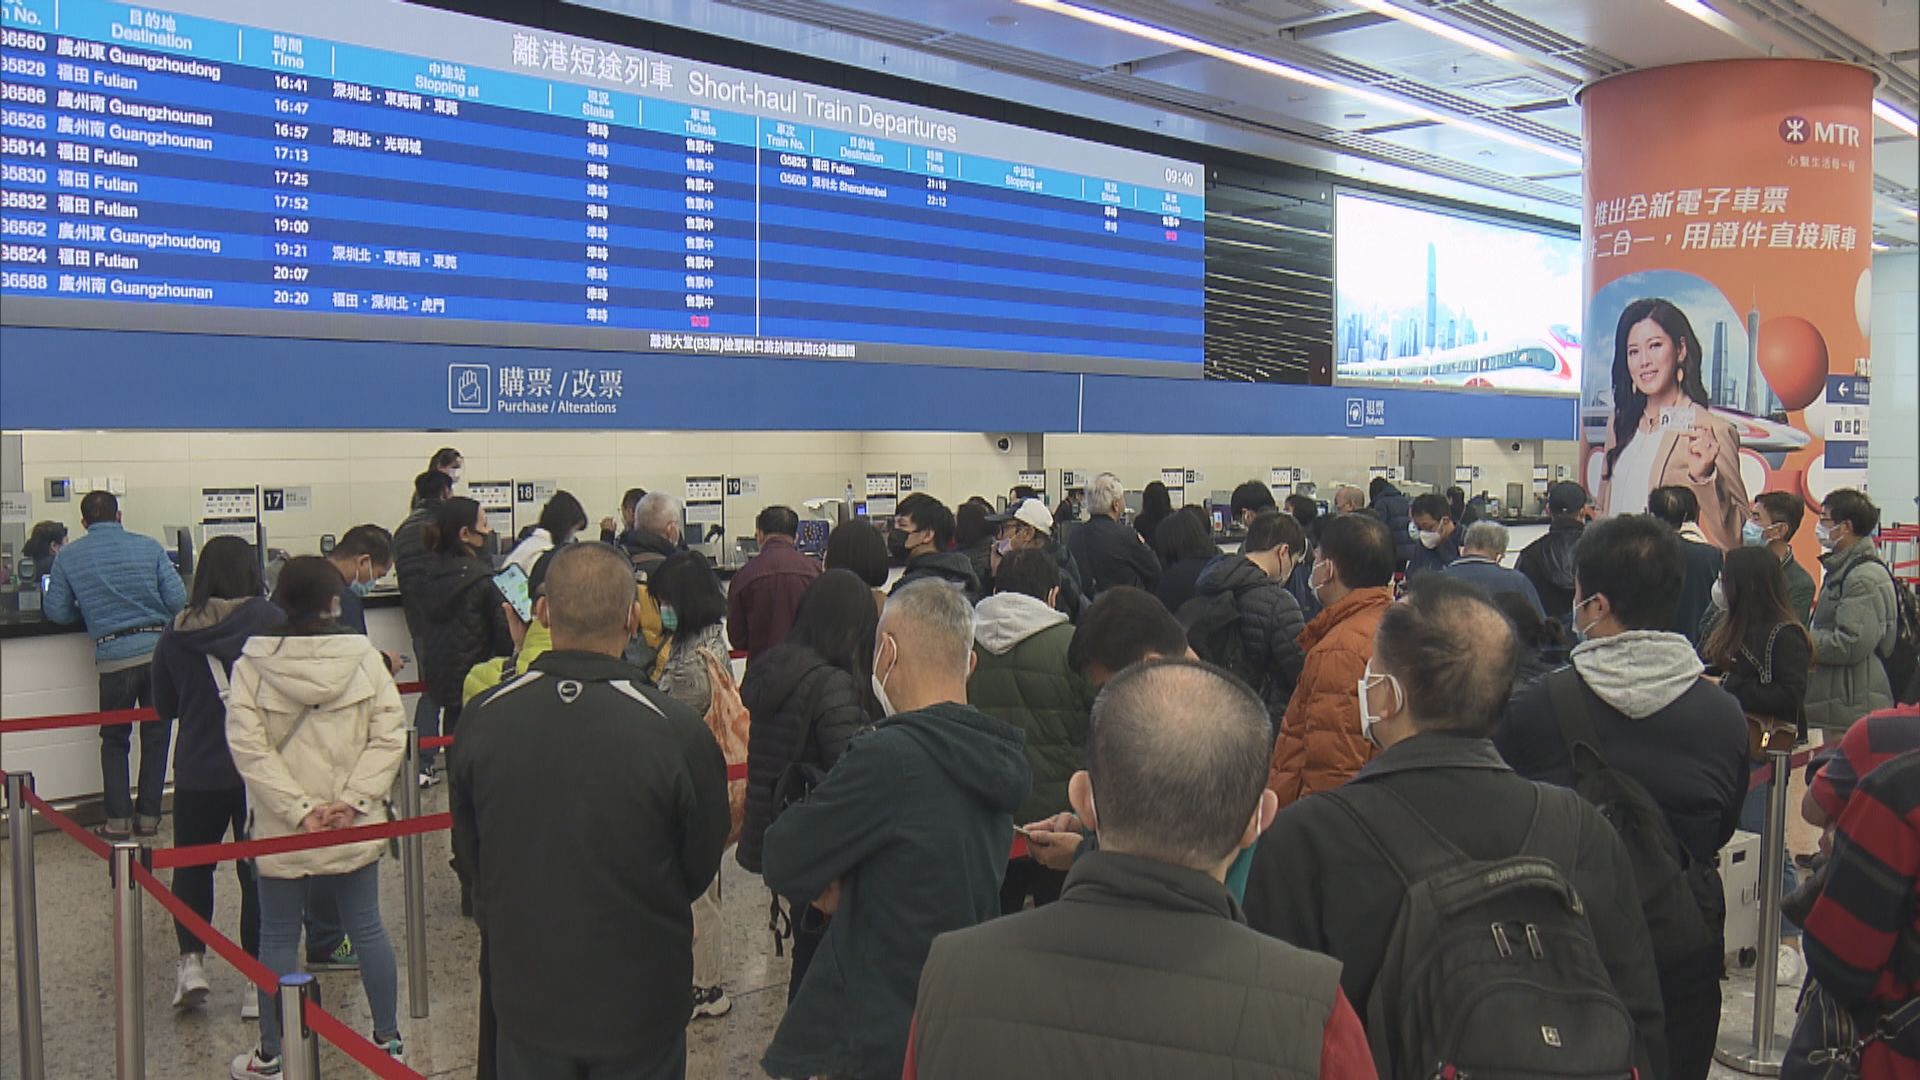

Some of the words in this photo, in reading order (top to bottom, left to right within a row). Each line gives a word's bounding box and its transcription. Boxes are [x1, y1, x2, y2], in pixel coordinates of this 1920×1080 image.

[129, 8, 176, 33] 目的地
[111, 22, 193, 51] Destination
[273, 34, 302, 54] 時間
[57, 38, 106, 60] 廣州東
[109, 47, 221, 81] Guangzhoudong
[274, 75, 308, 92] 16:41
[271, 50, 304, 70] Time
[512, 32, 674, 92] 離港短途列車
[57, 63, 89, 83] 福田
[94, 71, 138, 91] Futian
[274, 98, 309, 115] 16:47
[415, 73, 465, 98] Stopping
[467, 85, 479, 98] at
[57, 90, 105, 113] 廣州南
[109, 98, 213, 127] Guangzhounan
[274, 122, 309, 139] 16:57
[582, 102, 615, 120] Status
[688, 71, 797, 114] Short-haul
[803, 92, 852, 124] Train
[858, 103, 957, 145] Departures
[57, 115, 105, 138] 廣州南
[109, 124, 213, 151] Guangzhounan
[274, 146, 309, 162] 17:13
[684, 119, 717, 138] Tickets
[1814, 121, 1860, 148] MTR
[766, 133, 788, 148] Train
[790, 138, 804, 151] No.
[840, 146, 884, 164] Destination
[57, 142, 89, 163] 福田
[94, 148, 138, 168] Futian
[274, 170, 309, 187] 17:25
[831, 162, 855, 176] Futian
[1164, 167, 1194, 188] 09:40
[58, 169, 89, 189] 福田
[94, 175, 138, 194] Futian
[274, 194, 309, 210] 17:52
[58, 194, 90, 215] 福田
[94, 200, 138, 218] Futian
[274, 218, 309, 234] 19:00
[1593, 186, 1789, 228] 推出全新電子車票
[58, 222, 106, 242] 廣州東
[110, 227, 221, 253] Guangzhoudong
[274, 243, 308, 258] 19:21
[58, 247, 90, 267] 福田
[95, 252, 139, 269] Futian
[273, 266, 309, 281] 20:07
[58, 274, 106, 294] 廣州南
[110, 279, 213, 299] Guangzhounan
[273, 290, 309, 305] 20:20
[498, 399, 549, 414] Purchase
[557, 400, 617, 414] Alterations
[518, 485, 533, 500] 18
[728, 478, 740, 494] 19
[901, 475, 912, 489] 20
[265, 493, 282, 508] 17
